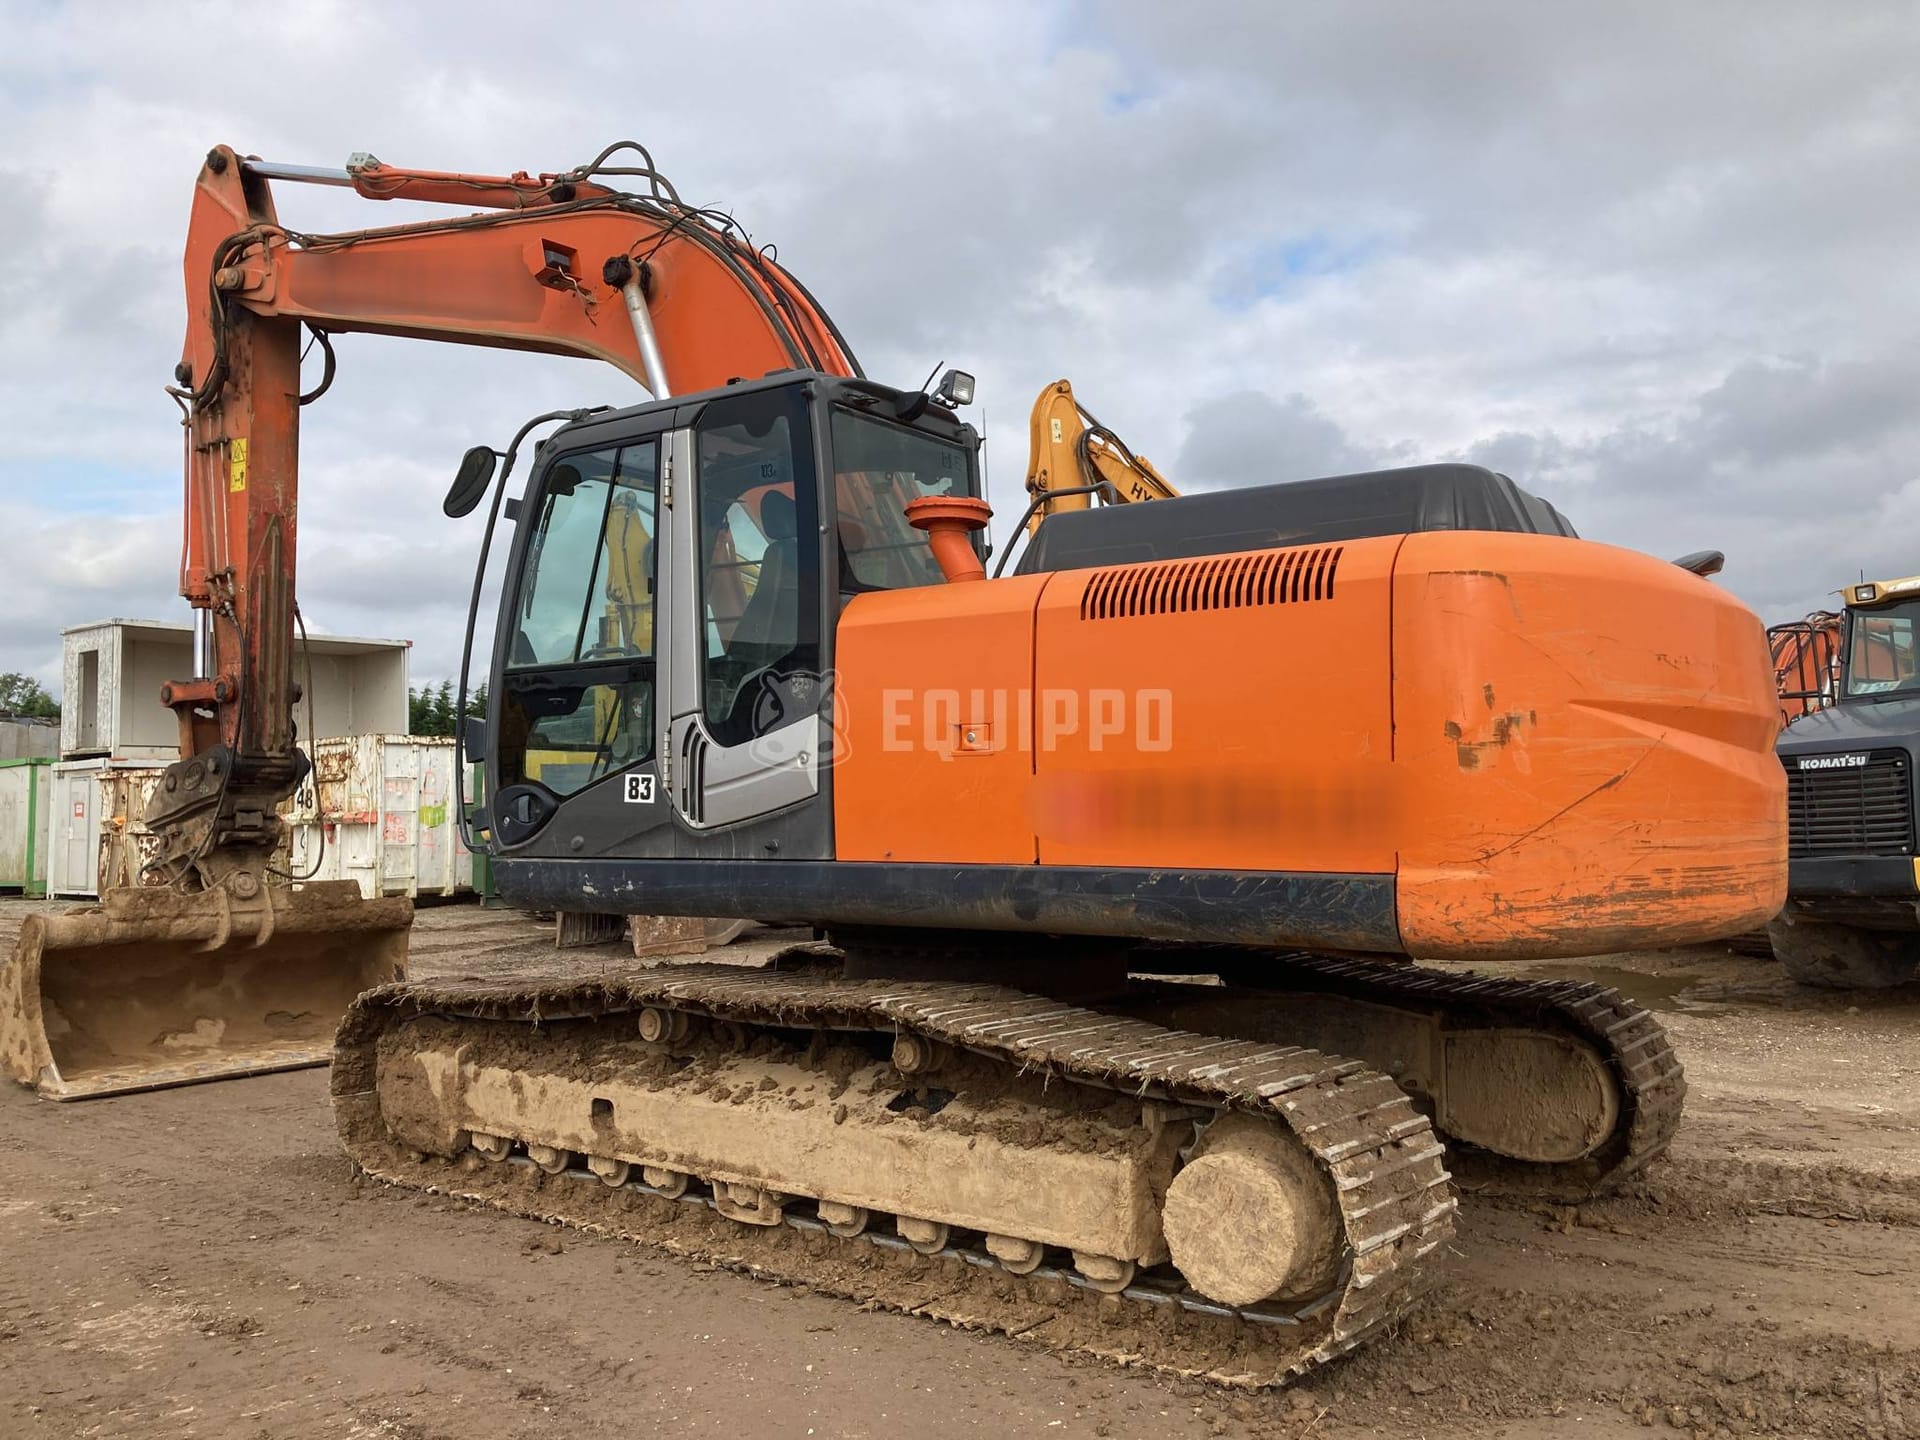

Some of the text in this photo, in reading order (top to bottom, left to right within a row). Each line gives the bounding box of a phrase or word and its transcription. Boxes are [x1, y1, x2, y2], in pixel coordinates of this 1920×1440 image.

[1131, 482, 1153, 501] HY
[1800, 754, 1866, 769] KOMATSU
[297, 788, 313, 809] 48
[628, 777, 652, 800] 83
